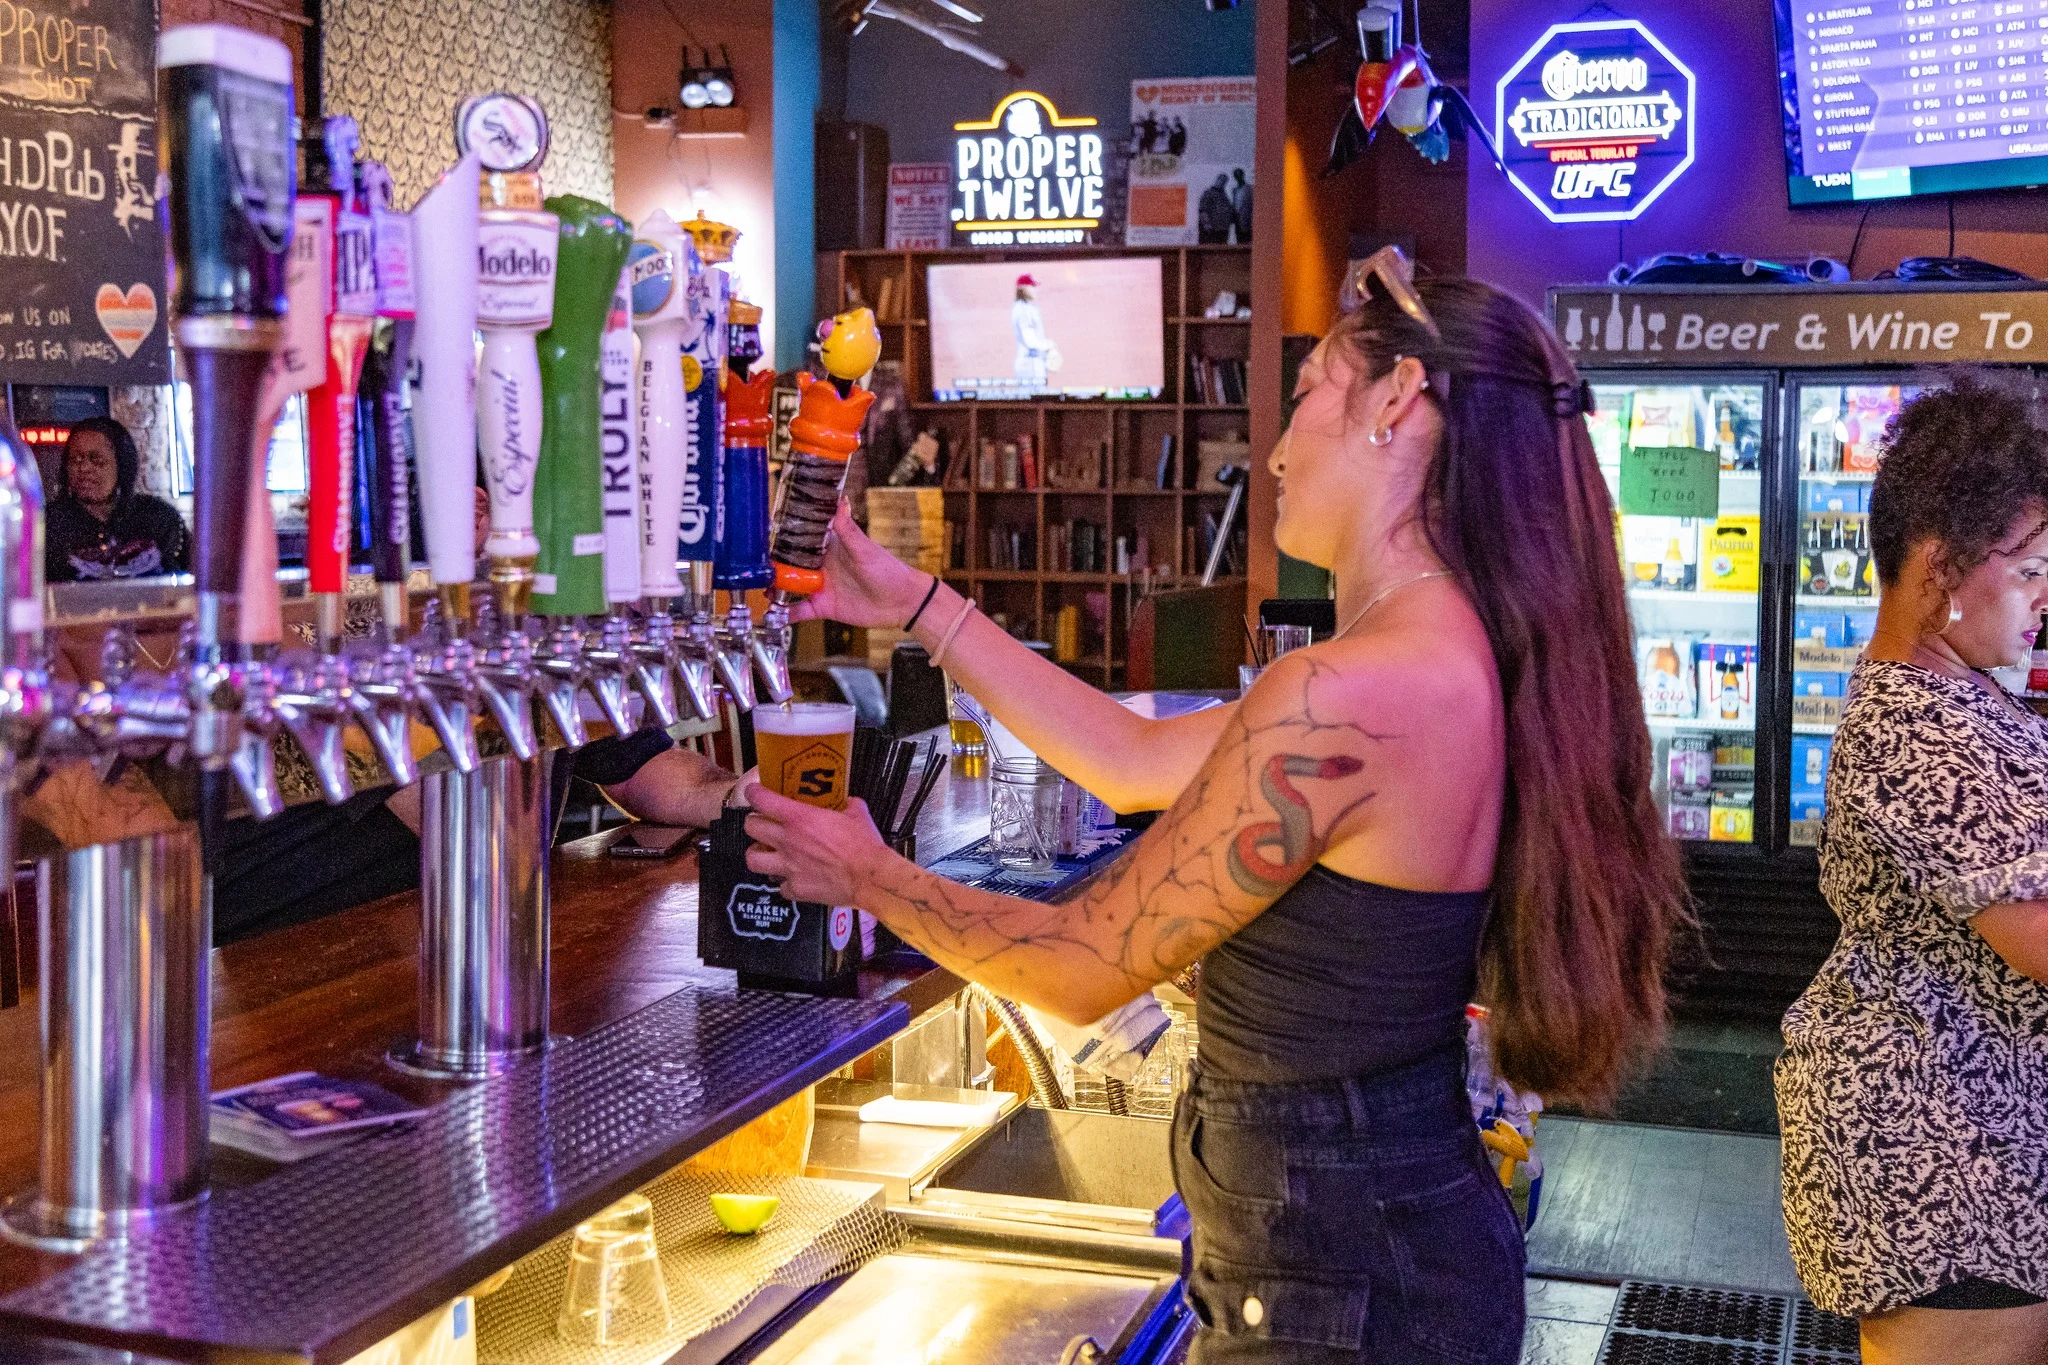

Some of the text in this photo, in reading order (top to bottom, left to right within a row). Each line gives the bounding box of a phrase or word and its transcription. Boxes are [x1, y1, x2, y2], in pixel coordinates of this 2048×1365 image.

[0, 2, 118, 71] PROPER
[31, 72, 95, 103] SHOT
[1824, 91, 1855, 103] GIRONA
[1527, 104, 1661, 132] TRADICIONAL
[1825, 106, 1871, 120] STUTTGART
[957, 134, 1103, 180] PROPER
[1550, 146, 1638, 162] OFFICIAL TEQUILA OF
[1812, 172, 1851, 188] TUDN
[958, 176, 1104, 221] TWELVE
[50, 306, 71, 326] ON
[1675, 311, 2034, 350] Beer & Wine To
[639, 361, 656, 547] BELGIAN WHITE
[1800, 650, 1842, 664] Modelo
[798, 768, 835, 797] S
[737, 901, 789, 917] KRAKEN
[755, 920, 771, 928] RUM
